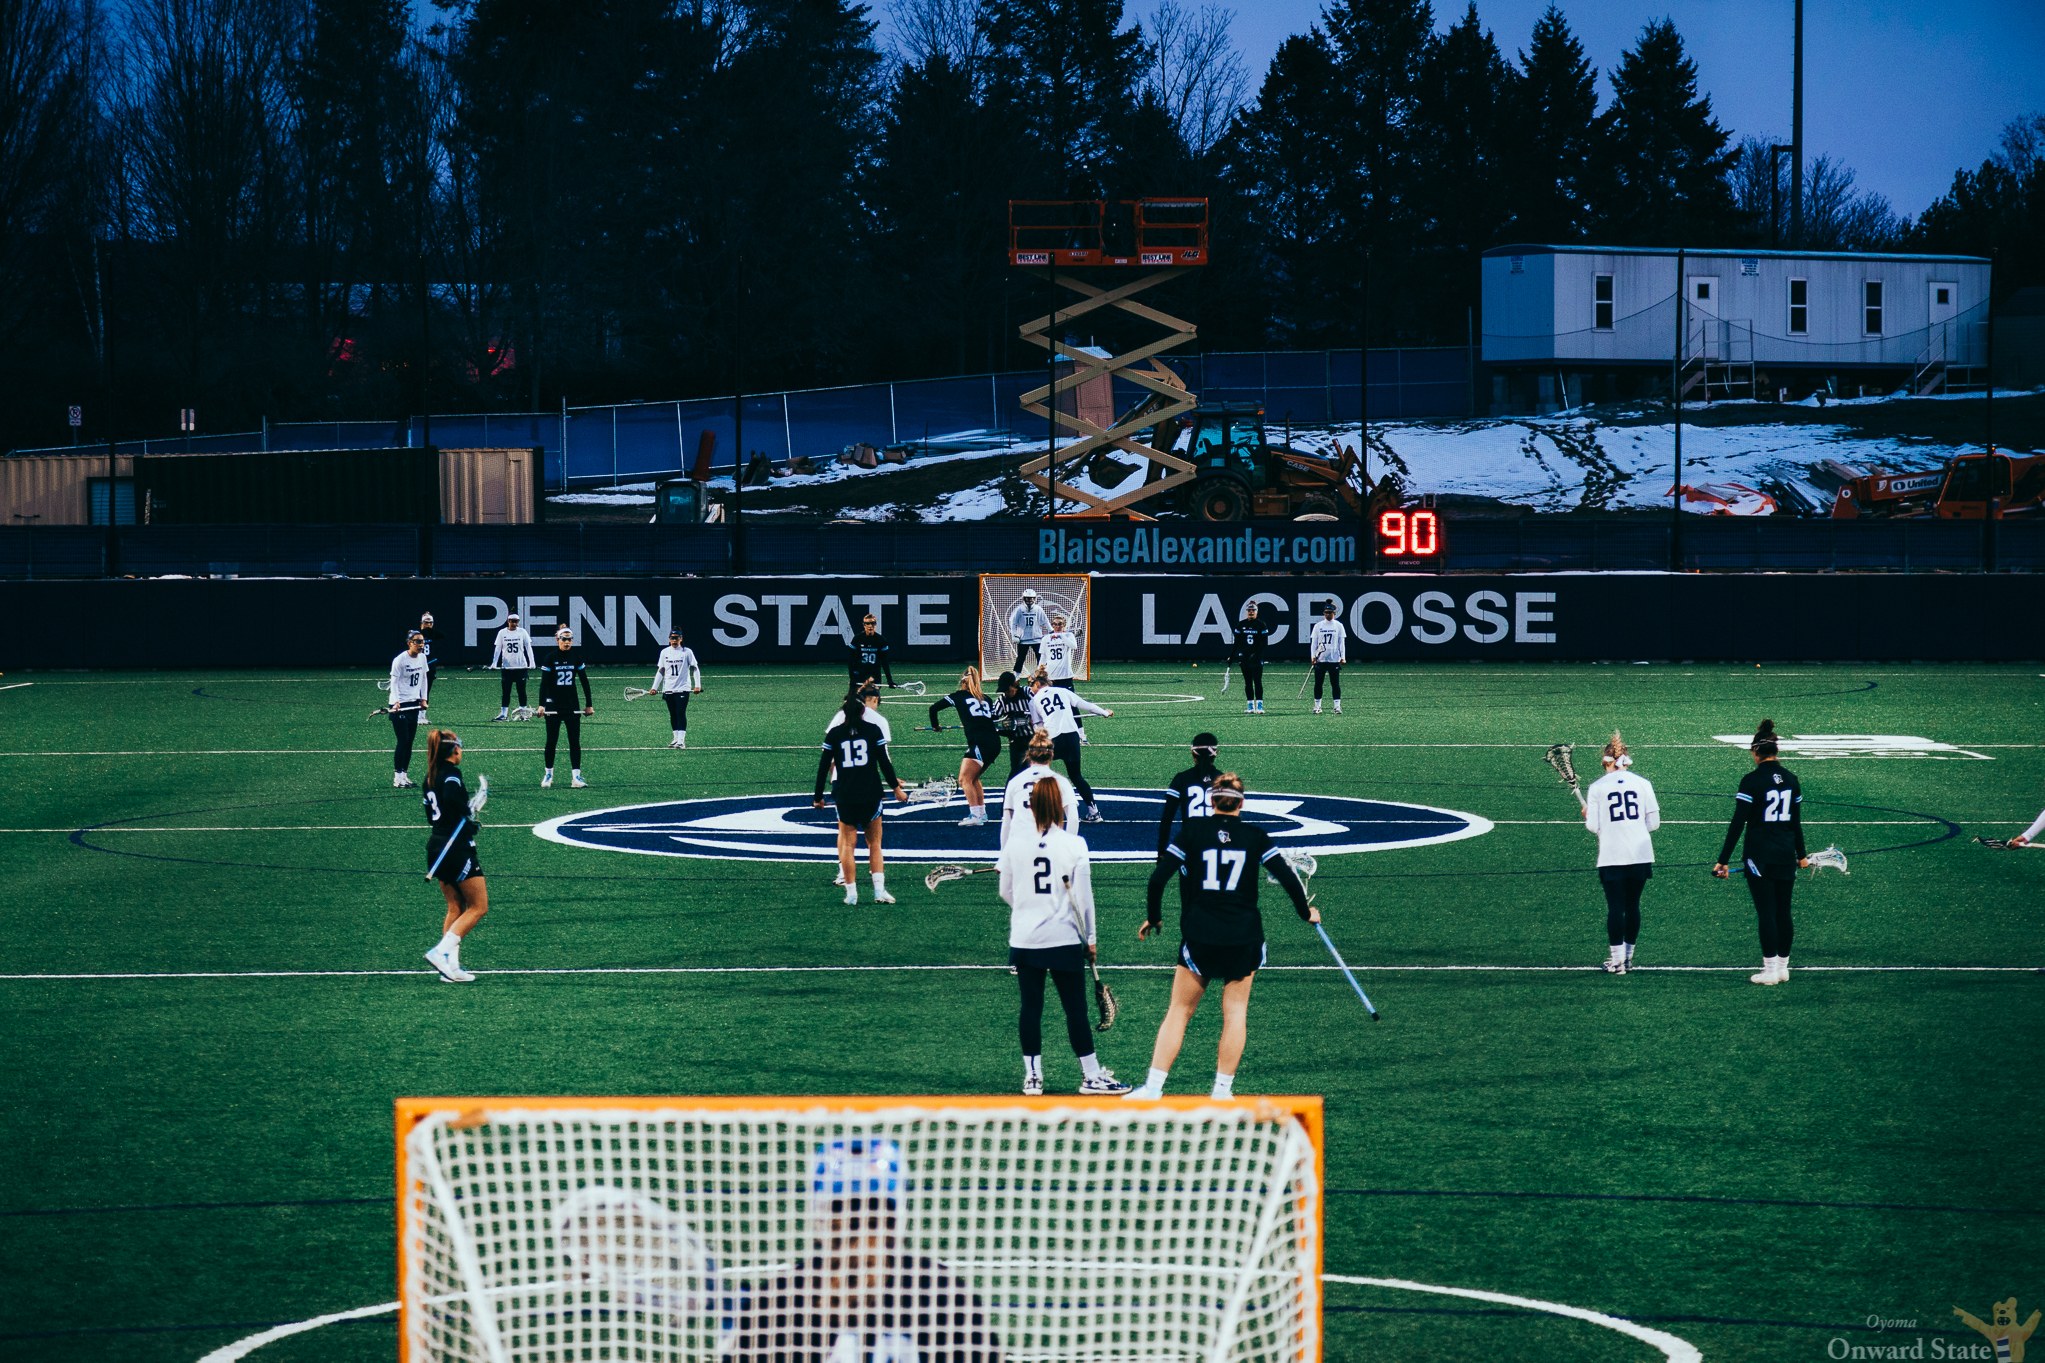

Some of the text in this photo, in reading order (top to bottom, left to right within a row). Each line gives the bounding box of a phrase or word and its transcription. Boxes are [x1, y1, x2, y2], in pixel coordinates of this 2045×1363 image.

[1181, 250, 1200, 258] JLG
[1287, 460, 1310, 472] CASE
[1907, 477, 1939, 489] United
[1382, 512, 1436, 555] 90
[1038, 527, 1356, 563] BlaiseAlexander.com
[464, 591, 1556, 647] PENN STATE LACROSSE
[1026, 617, 1034, 627] 16
[1246, 634, 1254, 645] 6
[1324, 633, 1333, 644] 17
[507, 642, 519, 653] 35
[1050, 647, 1062, 660] 36
[861, 652, 876, 665] 30
[671, 664, 679, 676] 11
[410, 673, 420, 687] 18
[556, 670, 573, 686] 22
[965, 697, 992, 719] 23
[1040, 693, 1065, 716] 24
[840, 738, 869, 768] 13
[1607, 790, 1640, 822] 26
[1764, 789, 1792, 822] 21
[1034, 857, 1051, 894] 2
[1202, 849, 1247, 891] 17
